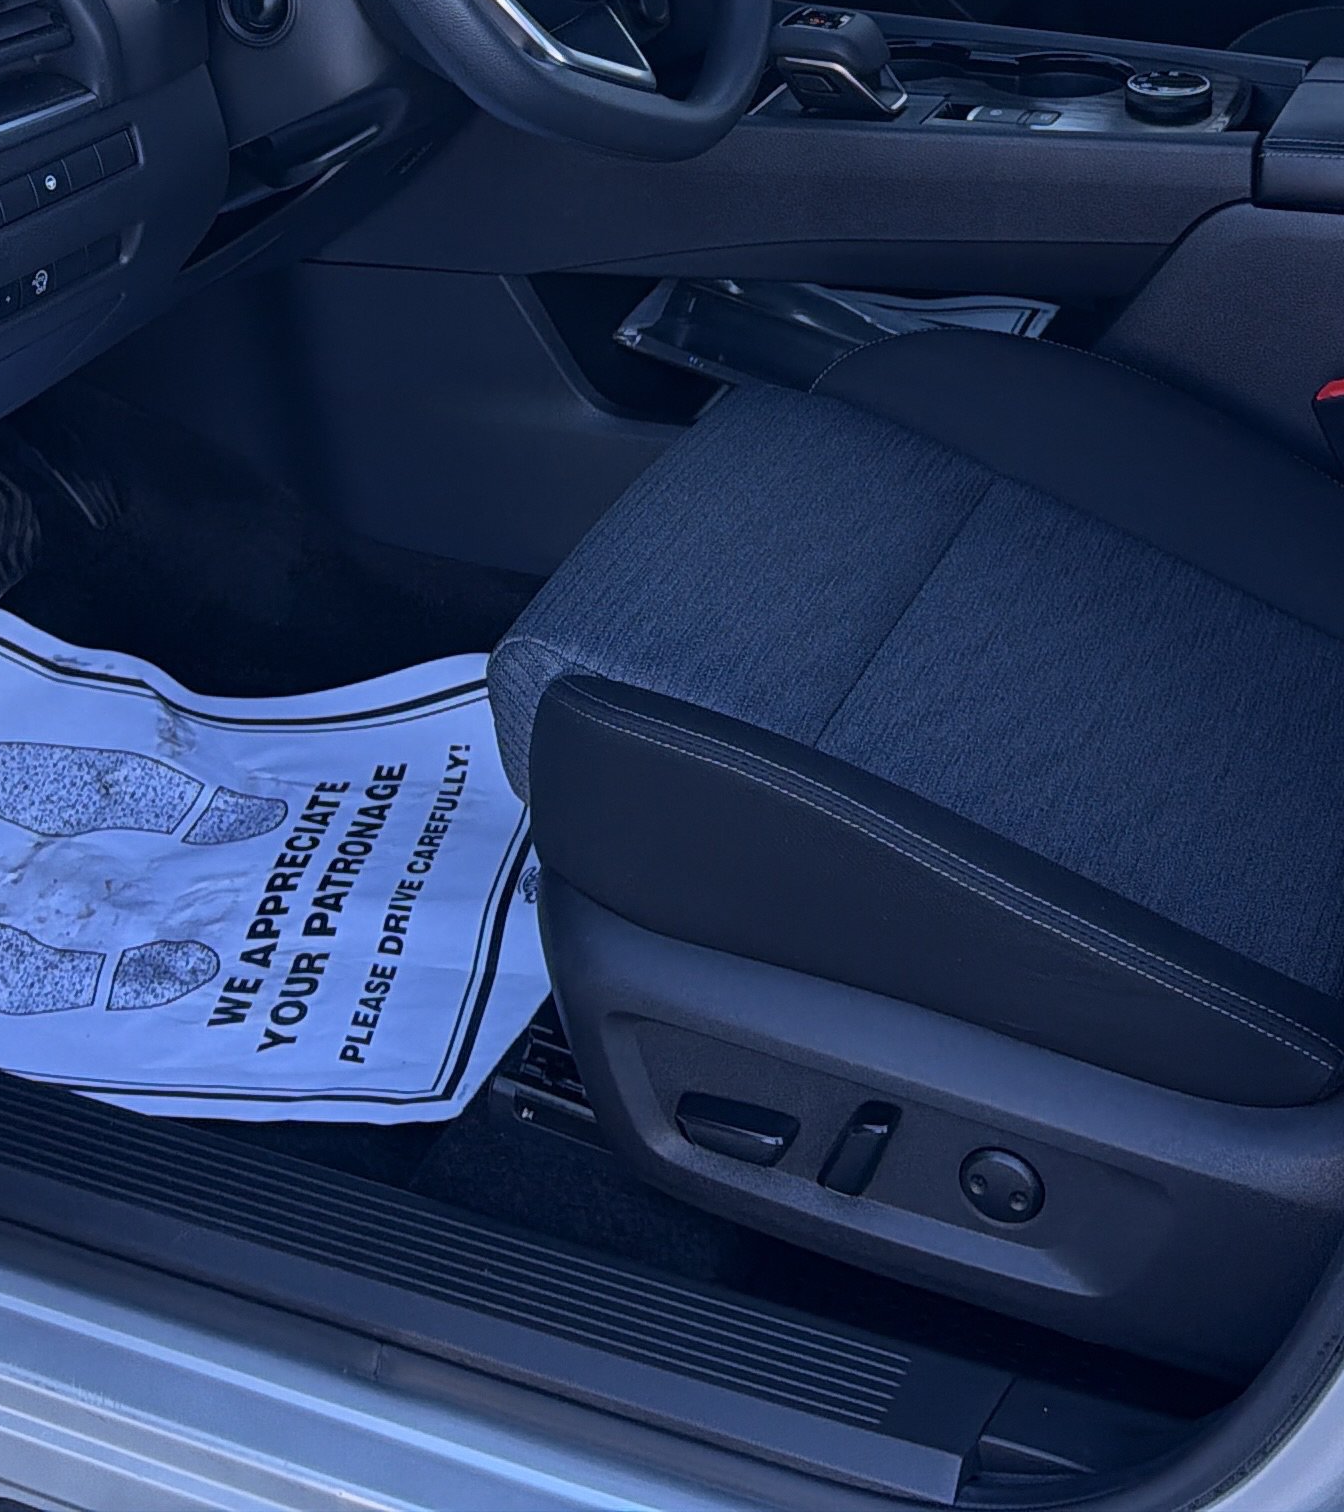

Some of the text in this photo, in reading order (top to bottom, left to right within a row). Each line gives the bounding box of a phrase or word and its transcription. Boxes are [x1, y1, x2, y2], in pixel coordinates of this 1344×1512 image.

[207, 781, 351, 1028] WE APPRECIATE
[256, 763, 407, 1053] YOUR PATRONAGE
[339, 744, 471, 1064] PLEASE DRIVE CAREFULLY!
